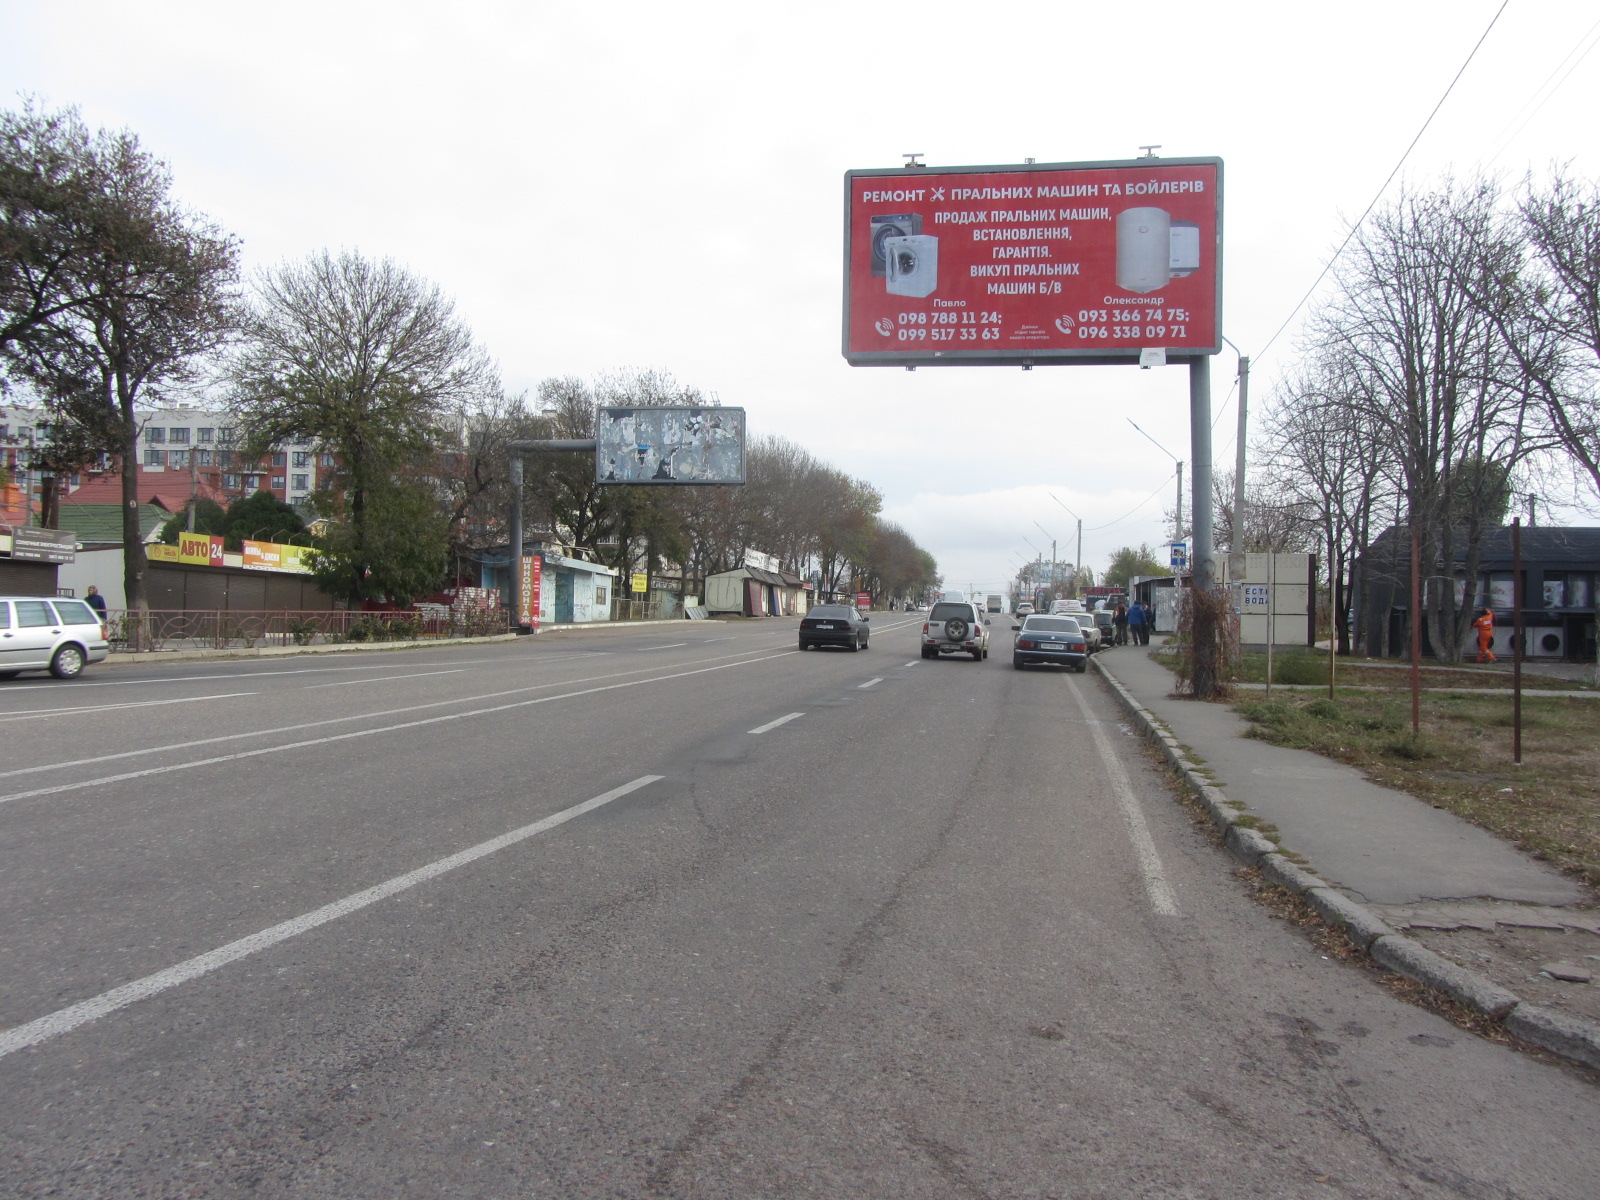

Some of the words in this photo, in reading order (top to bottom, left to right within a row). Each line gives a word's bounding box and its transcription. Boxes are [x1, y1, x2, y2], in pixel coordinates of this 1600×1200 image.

[863, 190, 925, 202] РЕМОНТ
[952, 187, 1032, 200] ПРАЛЬНИХ
[1038, 185, 1098, 198] МАШИН
[1102, 184, 1121, 195] ТА
[1126, 179, 1204, 195] БОЙЛЕРІВ
[935, 211, 987, 224] ПРОДАЖ
[991, 209, 1056, 222] ПРАЛЬНИХ
[1060, 208, 1111, 221] МАШИН,
[974, 227, 1072, 241] ВСТАНОВЛЕННЯ,
[993, 246, 1051, 258] ГАРАНТІЯ.
[971, 265, 1010, 276] ВИКУП
[1014, 264, 1079, 275] ПРАЛЬНИХ
[988, 283, 1035, 294] МАШИН
[1040, 280, 1061, 295] Б/В
[934, 299, 966, 307] Павло
[1104, 296, 1164, 306] Олександр
[899, 313, 926, 324] 098
[931, 312, 957, 324] 788
[962, 312, 975, 323] 11
[980, 312, 1002, 324] 24;
[1079, 310, 1107, 322] 093
[1113, 310, 1140, 321] 366
[1146, 309, 1162, 321] 74
[1167, 309, 1189, 321] 75;
[898, 329, 926, 341] 099
[931, 329, 955, 340] 517
[960, 328, 976, 340] 33
[982, 328, 999, 340] 63
[1079, 326, 1108, 338] 096
[1113, 326, 1140, 338] 338
[1146, 326, 1165, 338] 09
[1171, 326, 1186, 337] 71
[181, 539, 208, 558] АВТО
[211, 543, 222, 559] 24
[521, 557, 532, 624] ШИНОМОНТАЖ
